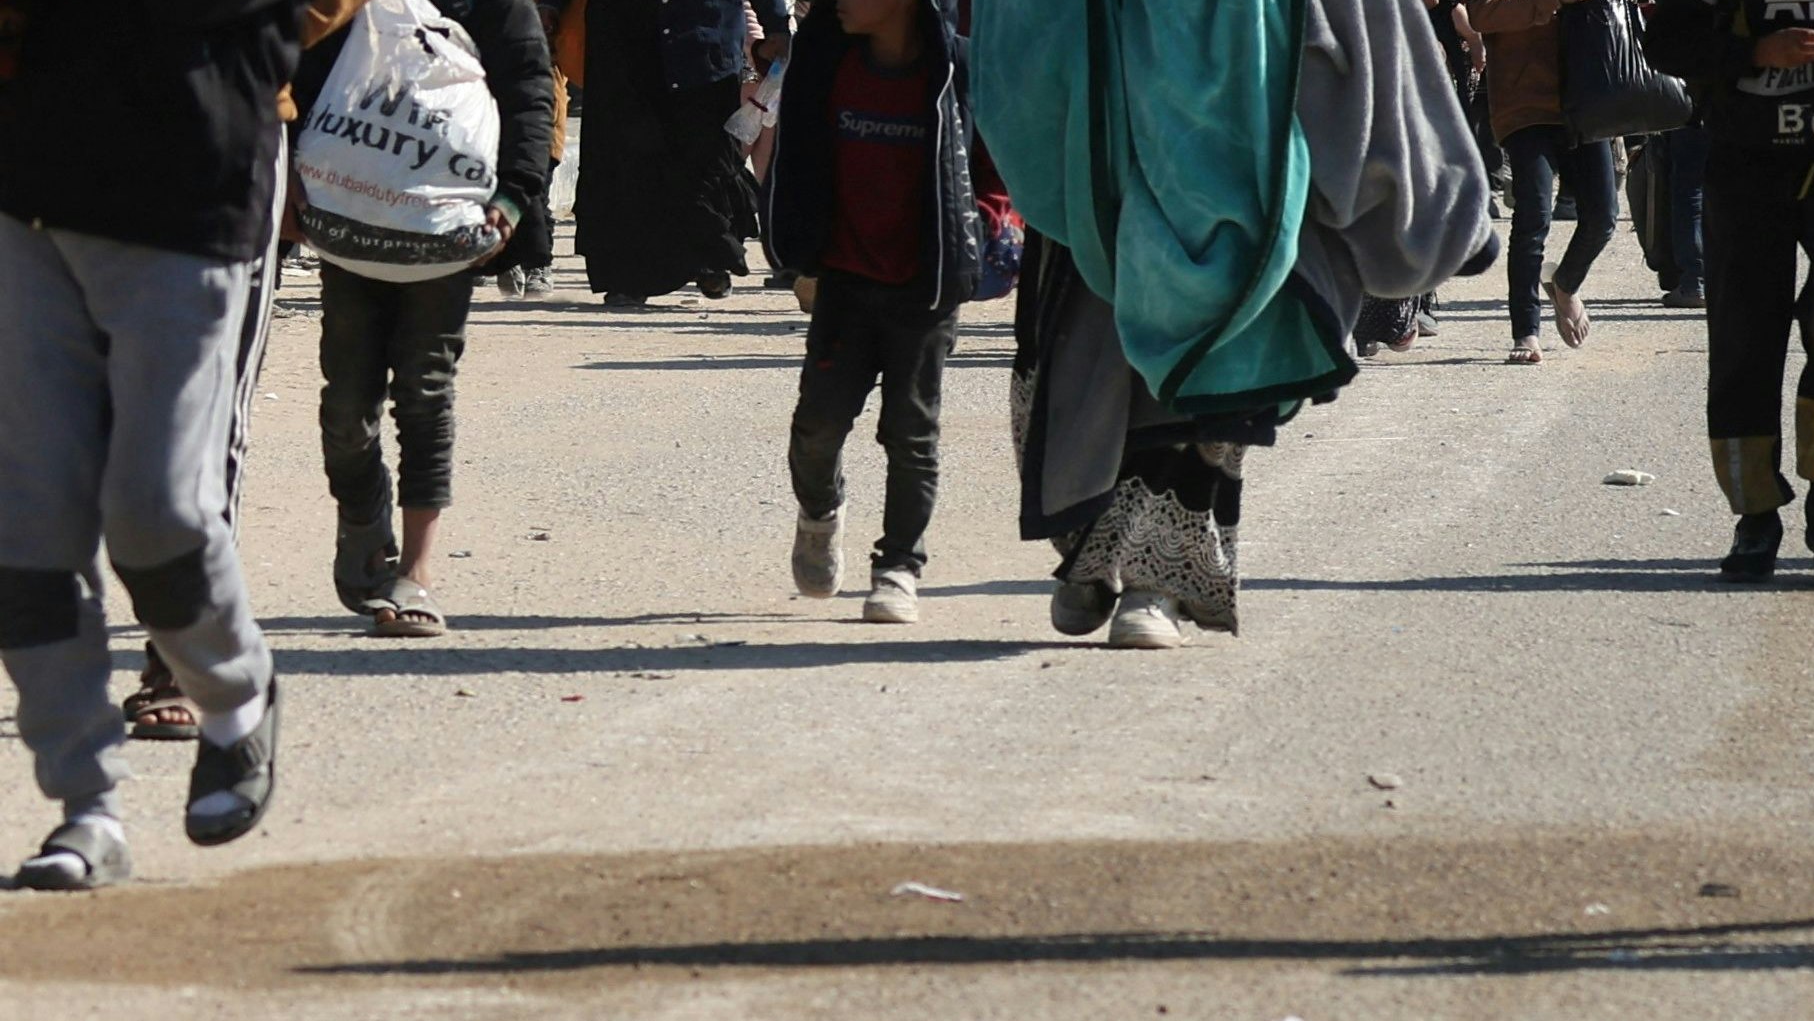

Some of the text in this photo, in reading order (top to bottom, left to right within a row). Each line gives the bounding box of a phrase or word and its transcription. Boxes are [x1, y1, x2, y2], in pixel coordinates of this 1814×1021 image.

[313, 103, 440, 170] luxury
[302, 215, 322, 230] ull
[328, 224, 350, 239] of
